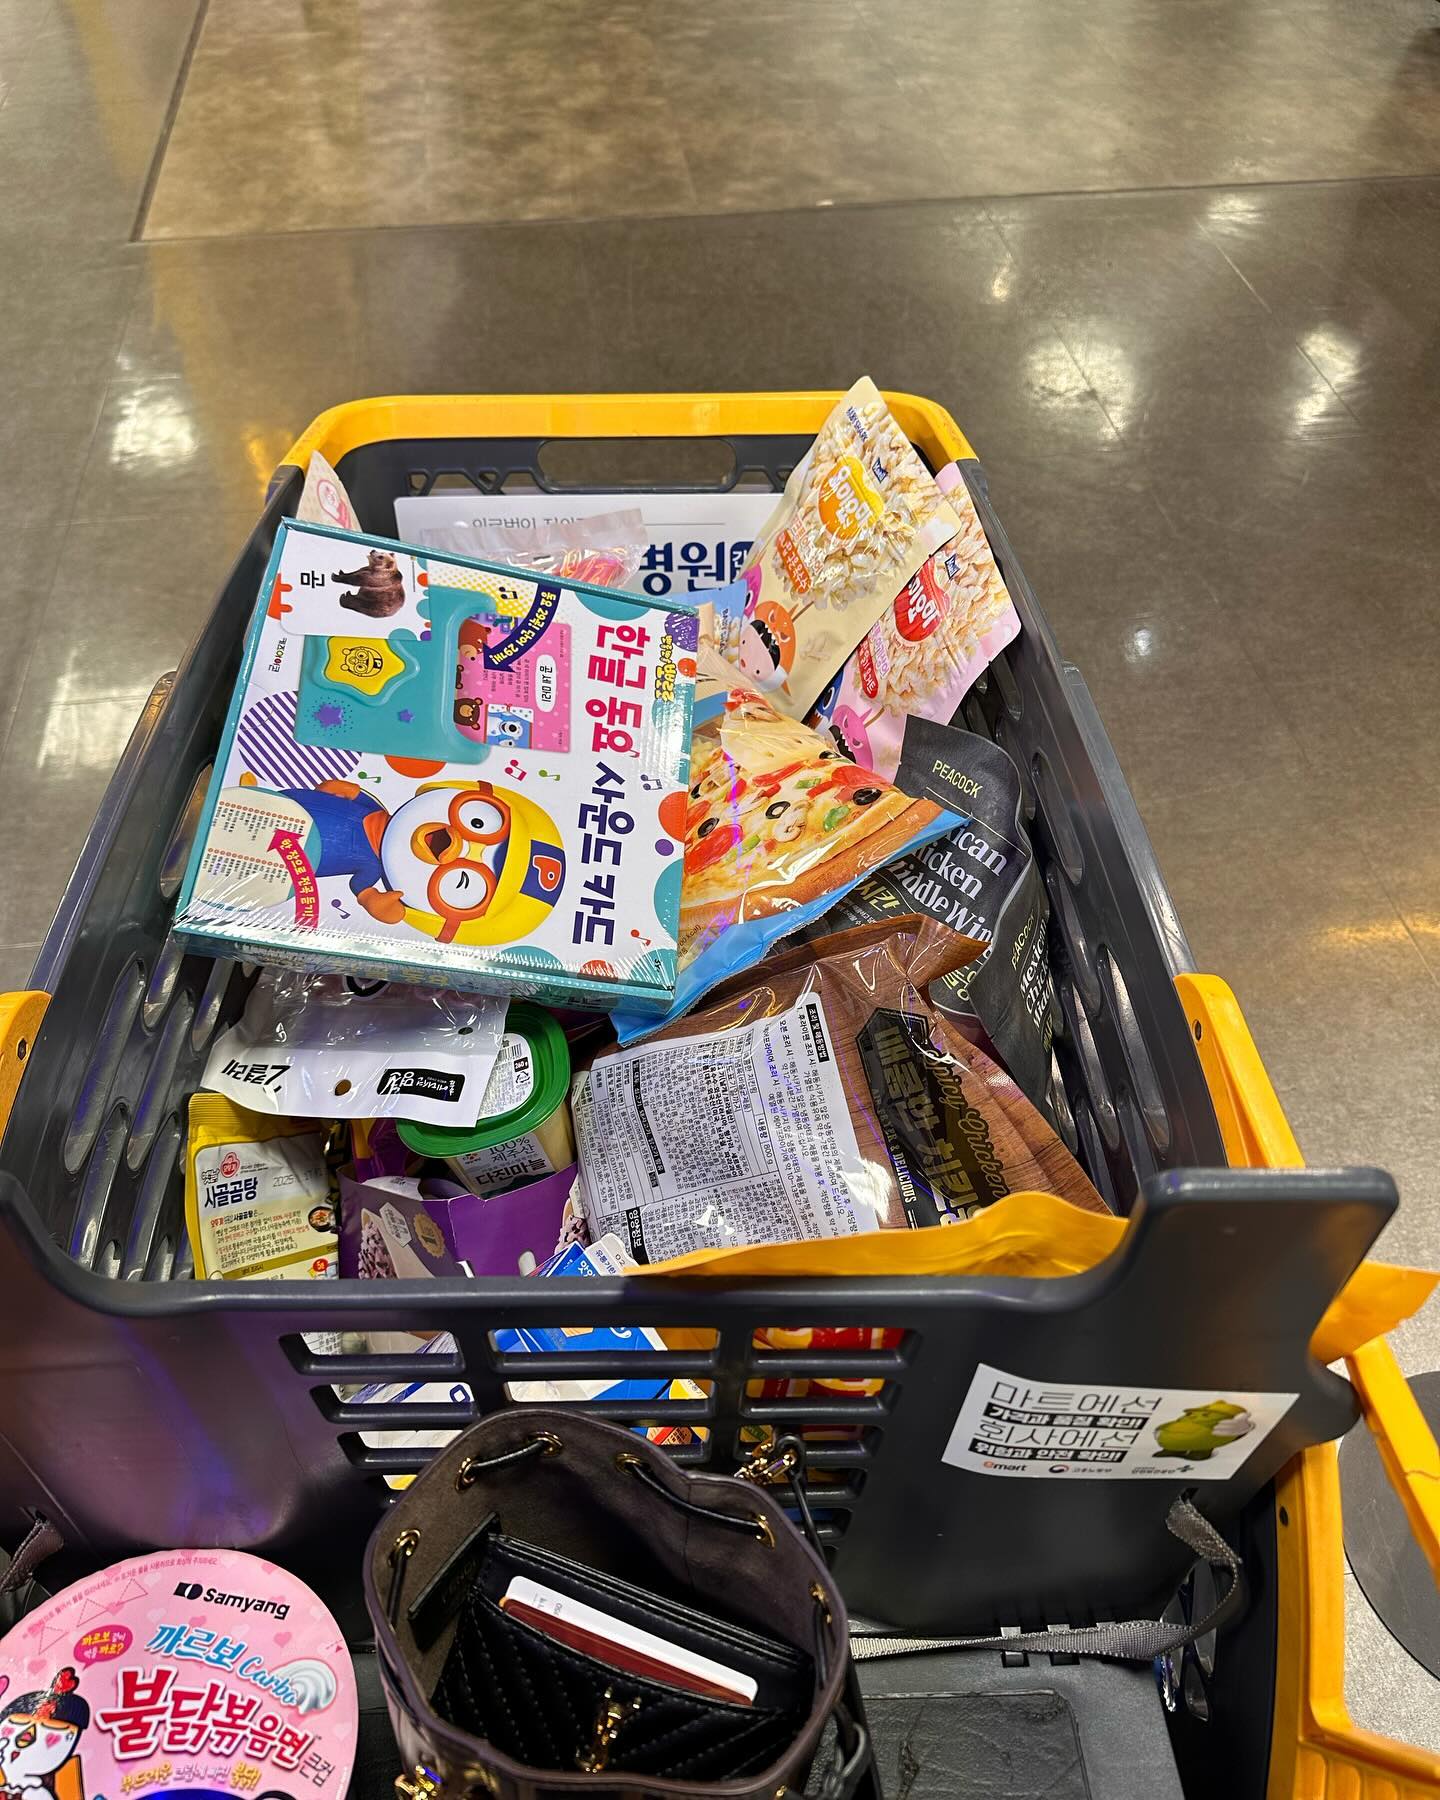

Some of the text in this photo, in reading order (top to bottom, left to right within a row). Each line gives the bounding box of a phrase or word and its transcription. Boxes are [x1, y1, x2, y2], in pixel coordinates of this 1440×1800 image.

[300, 570, 325, 588] 곰
[539, 591, 556, 608] 동요
[907, 576, 942, 628] 미요미
[516, 628, 537, 646] 단어
[490, 644, 519, 666] 29개!
[539, 664, 553, 703] 곰 세 마리
[655, 662, 678, 702] 뽀로로
[572, 624, 651, 946] 한글 동요 사운드 카드
[932, 760, 983, 798] PEACOCK
[281, 838, 292, 849] 한
[950, 826, 1008, 876] ican
[921, 842, 984, 900] icken
[945, 903, 994, 943] Win
[777, 1019, 788, 1034] 오븐
[781, 1034, 792, 1048] 조리
[807, 1007, 818, 1022] 조리
[813, 1030, 827, 1058] 해동방법
[778, 1062, 788, 1071] 약
[784, 1048, 794, 1056] 시
[768, 1063, 778, 1078] 조리
[781, 1070, 797, 1103] 12-14분간
[786, 1060, 803, 1094] 해동시키지
[800, 1070, 815, 1092] 가열된
[874, 1025, 940, 1130] 매콤한
[740, 1052, 753, 1073] 콤한
[761, 1143, 773, 1158] 800
[789, 1103, 804, 1131] 가열하여
[806, 1093, 822, 1123] 식용유에
[796, 1013, 810, 1042] 후라이팬
[803, 1041, 814, 1057] 조리
[809, 1068, 826, 1105] 해동시키지
[822, 1120, 839, 1157] 냉동상태의
[844, 1209, 859, 1236] 적당량
[814, 1122, 824, 1131] 약
[924, 1046, 967, 1111] Spicy
[959, 1109, 1009, 1198] Chicken
[487, 1135, 530, 1155] 100%
[490, 1143, 536, 1164] 제주산
[816, 1130, 831, 1158] 6-7분간
[474, 1156, 547, 1187] 다진마늘
[893, 1151, 917, 1204] DELICIOUS
[201, 1176, 260, 1209] 사골곰탕
[830, 1186, 846, 1218] 드십시오.
[626, 1209, 644, 1248] 영양정보
[594, 1248, 617, 1276] 유통기한
[990, 1381, 1162, 1415] 마트에선
[974, 1419, 1140, 1449] 회사에선
[987, 1406, 1145, 1430] 가격과 품질 확인!
[974, 1443, 1034, 1461] 위험과
[1075, 1450, 1121, 1463] 확인!
[982, 1461, 1028, 1473] emart
[203, 1588, 290, 1620] Samyang
[145, 1624, 247, 1669] 까르보
[238, 1656, 296, 1705] Carbo
[100, 1669, 314, 1769] 불닭볶음면
[299, 1751, 335, 1787] 큰컵
